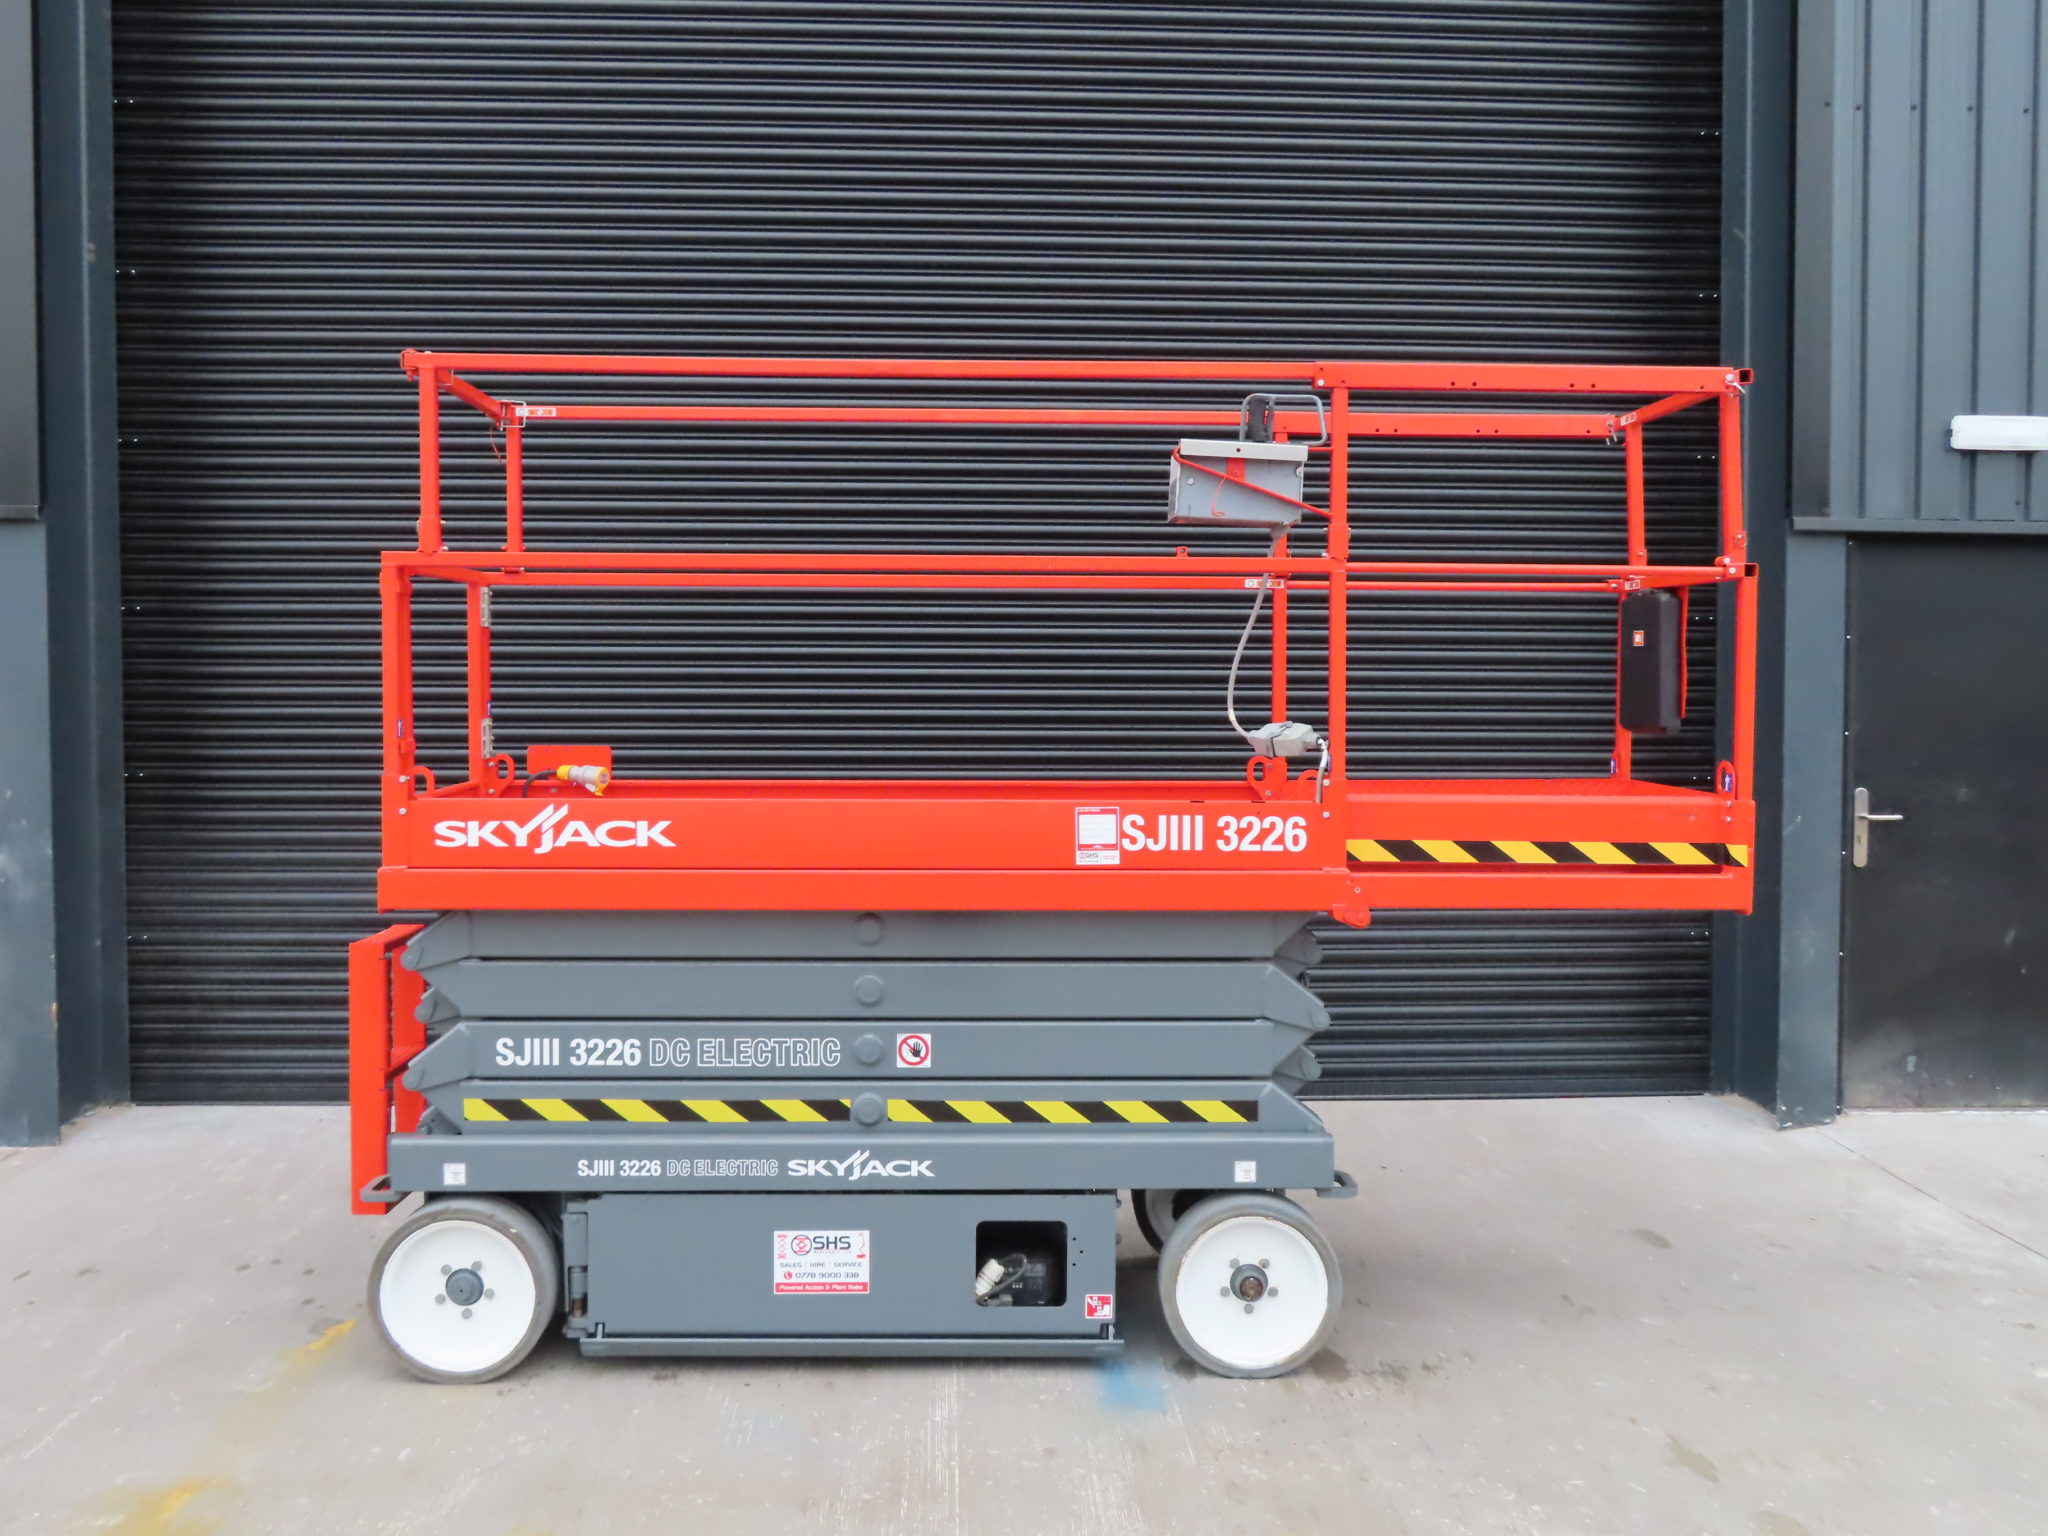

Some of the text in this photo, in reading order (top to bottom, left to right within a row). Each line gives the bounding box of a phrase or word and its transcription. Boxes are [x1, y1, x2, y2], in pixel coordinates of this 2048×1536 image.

[432, 803, 677, 852] SKYJACK
[1121, 813, 1308, 854] SJIII 3226
[495, 1037, 841, 1068] SJIII 3226 DC ELECTRIC
[577, 1150, 936, 1181] SJIII 3226 DC ELECTRIC SKYJACK
[813, 1236, 851, 1250] SHS
